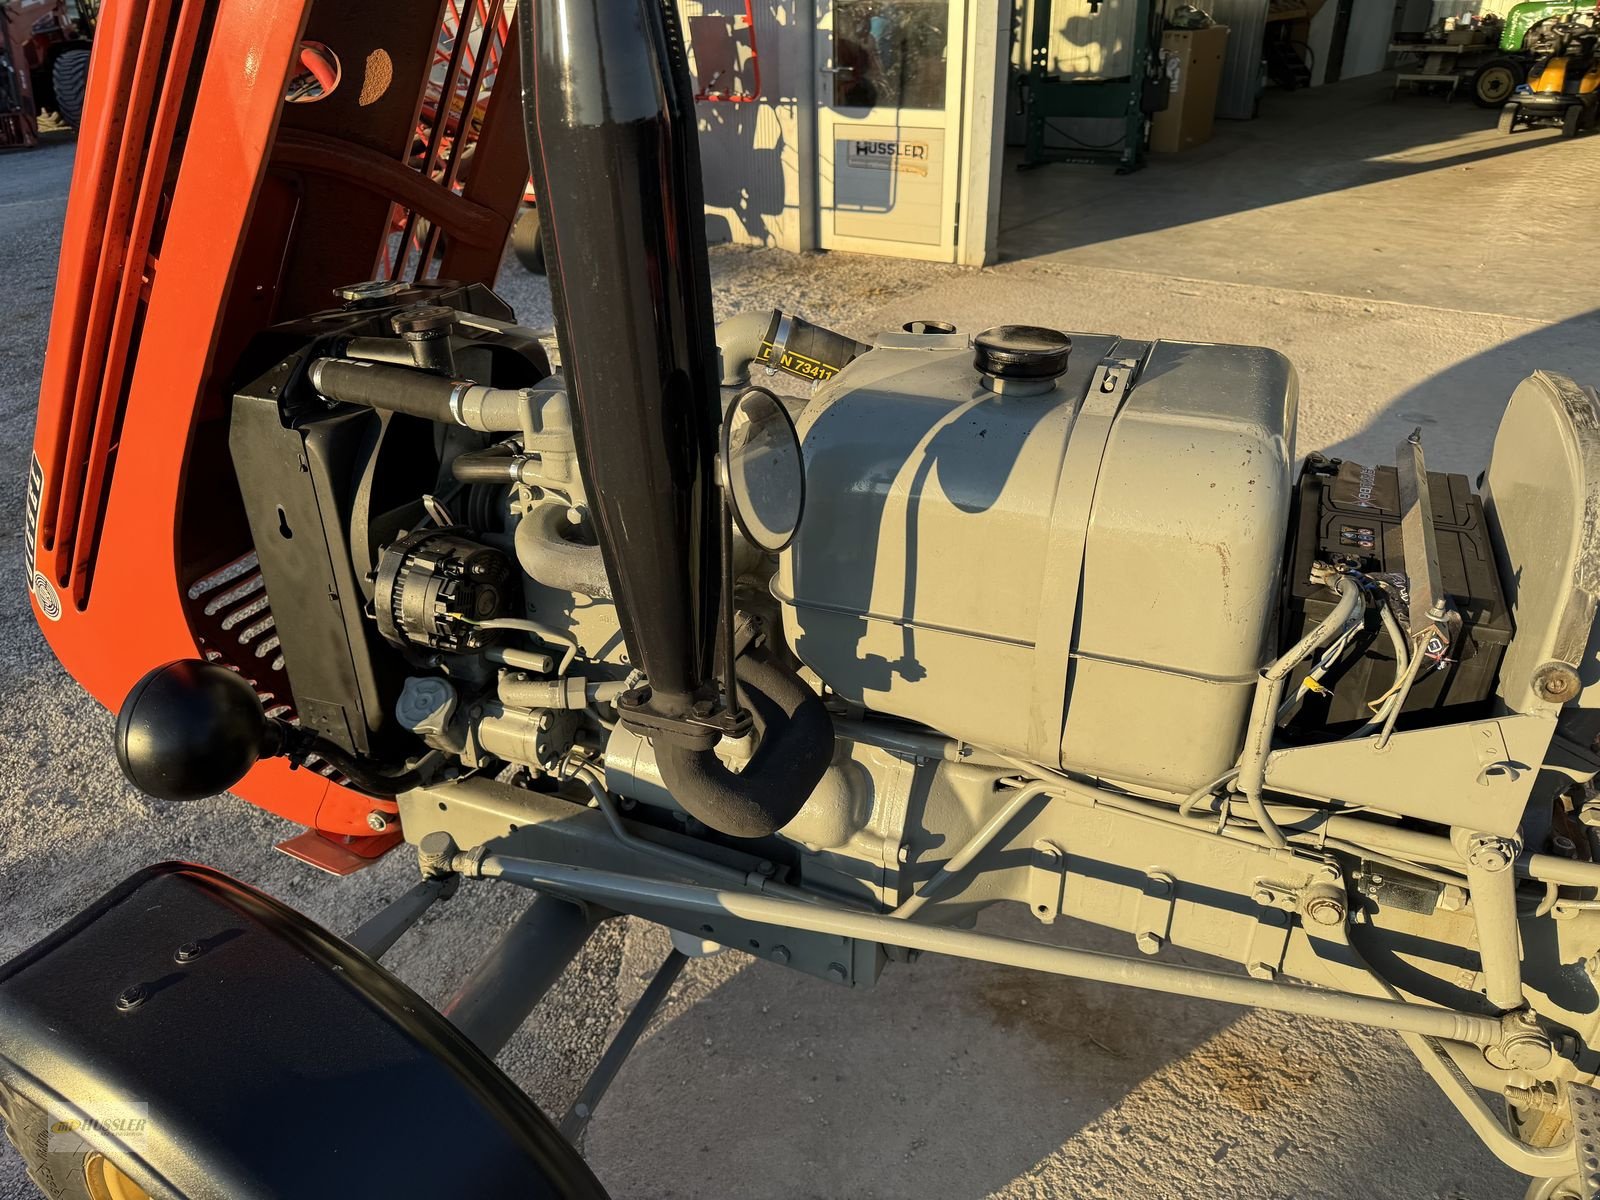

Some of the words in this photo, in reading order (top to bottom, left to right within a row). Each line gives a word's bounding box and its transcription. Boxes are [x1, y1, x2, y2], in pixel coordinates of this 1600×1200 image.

[856, 141, 924, 159] HUSSLER
[763, 347, 793, 367] DN
[795, 359, 832, 380] 73411
